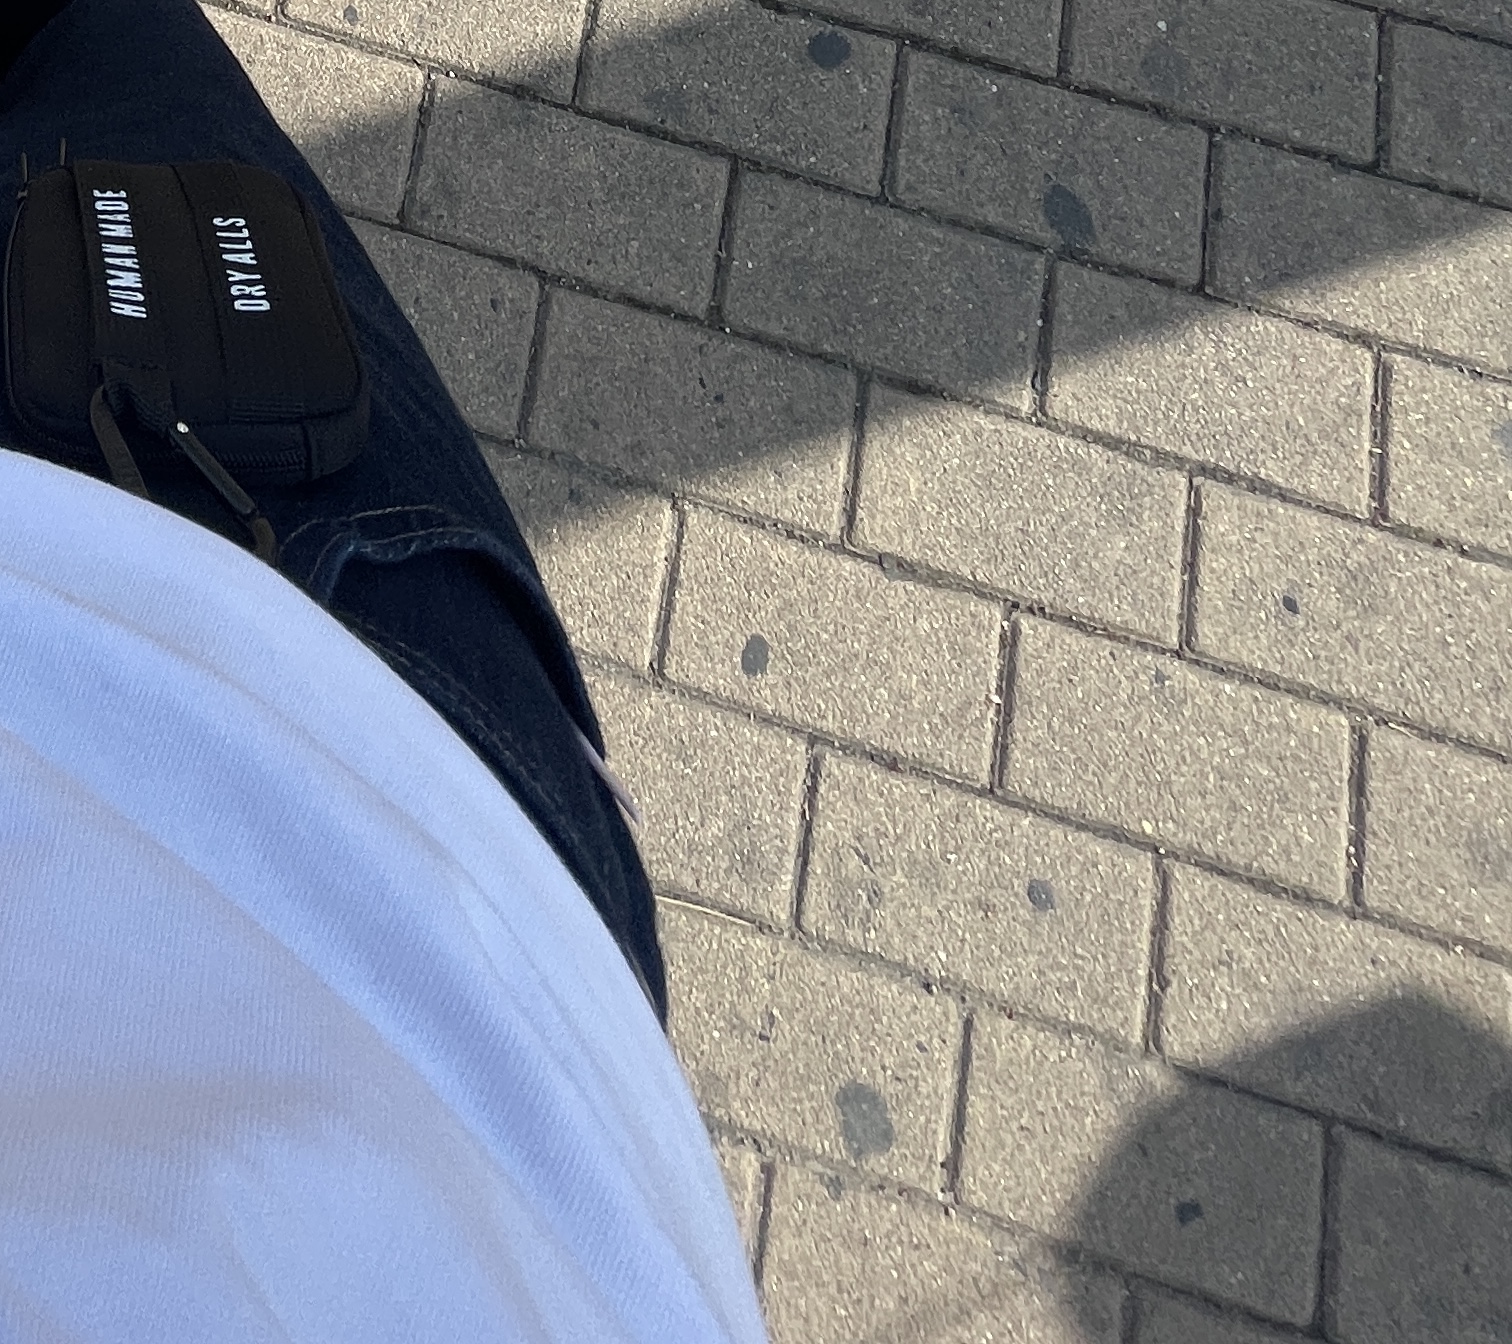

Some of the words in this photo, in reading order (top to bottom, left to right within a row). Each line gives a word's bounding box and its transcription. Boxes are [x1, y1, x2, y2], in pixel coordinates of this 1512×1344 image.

[92, 189, 135, 238] MADE
[212, 217, 258, 265] ALLS
[100, 242, 148, 319] HUMAN
[225, 269, 271, 312] DRY
